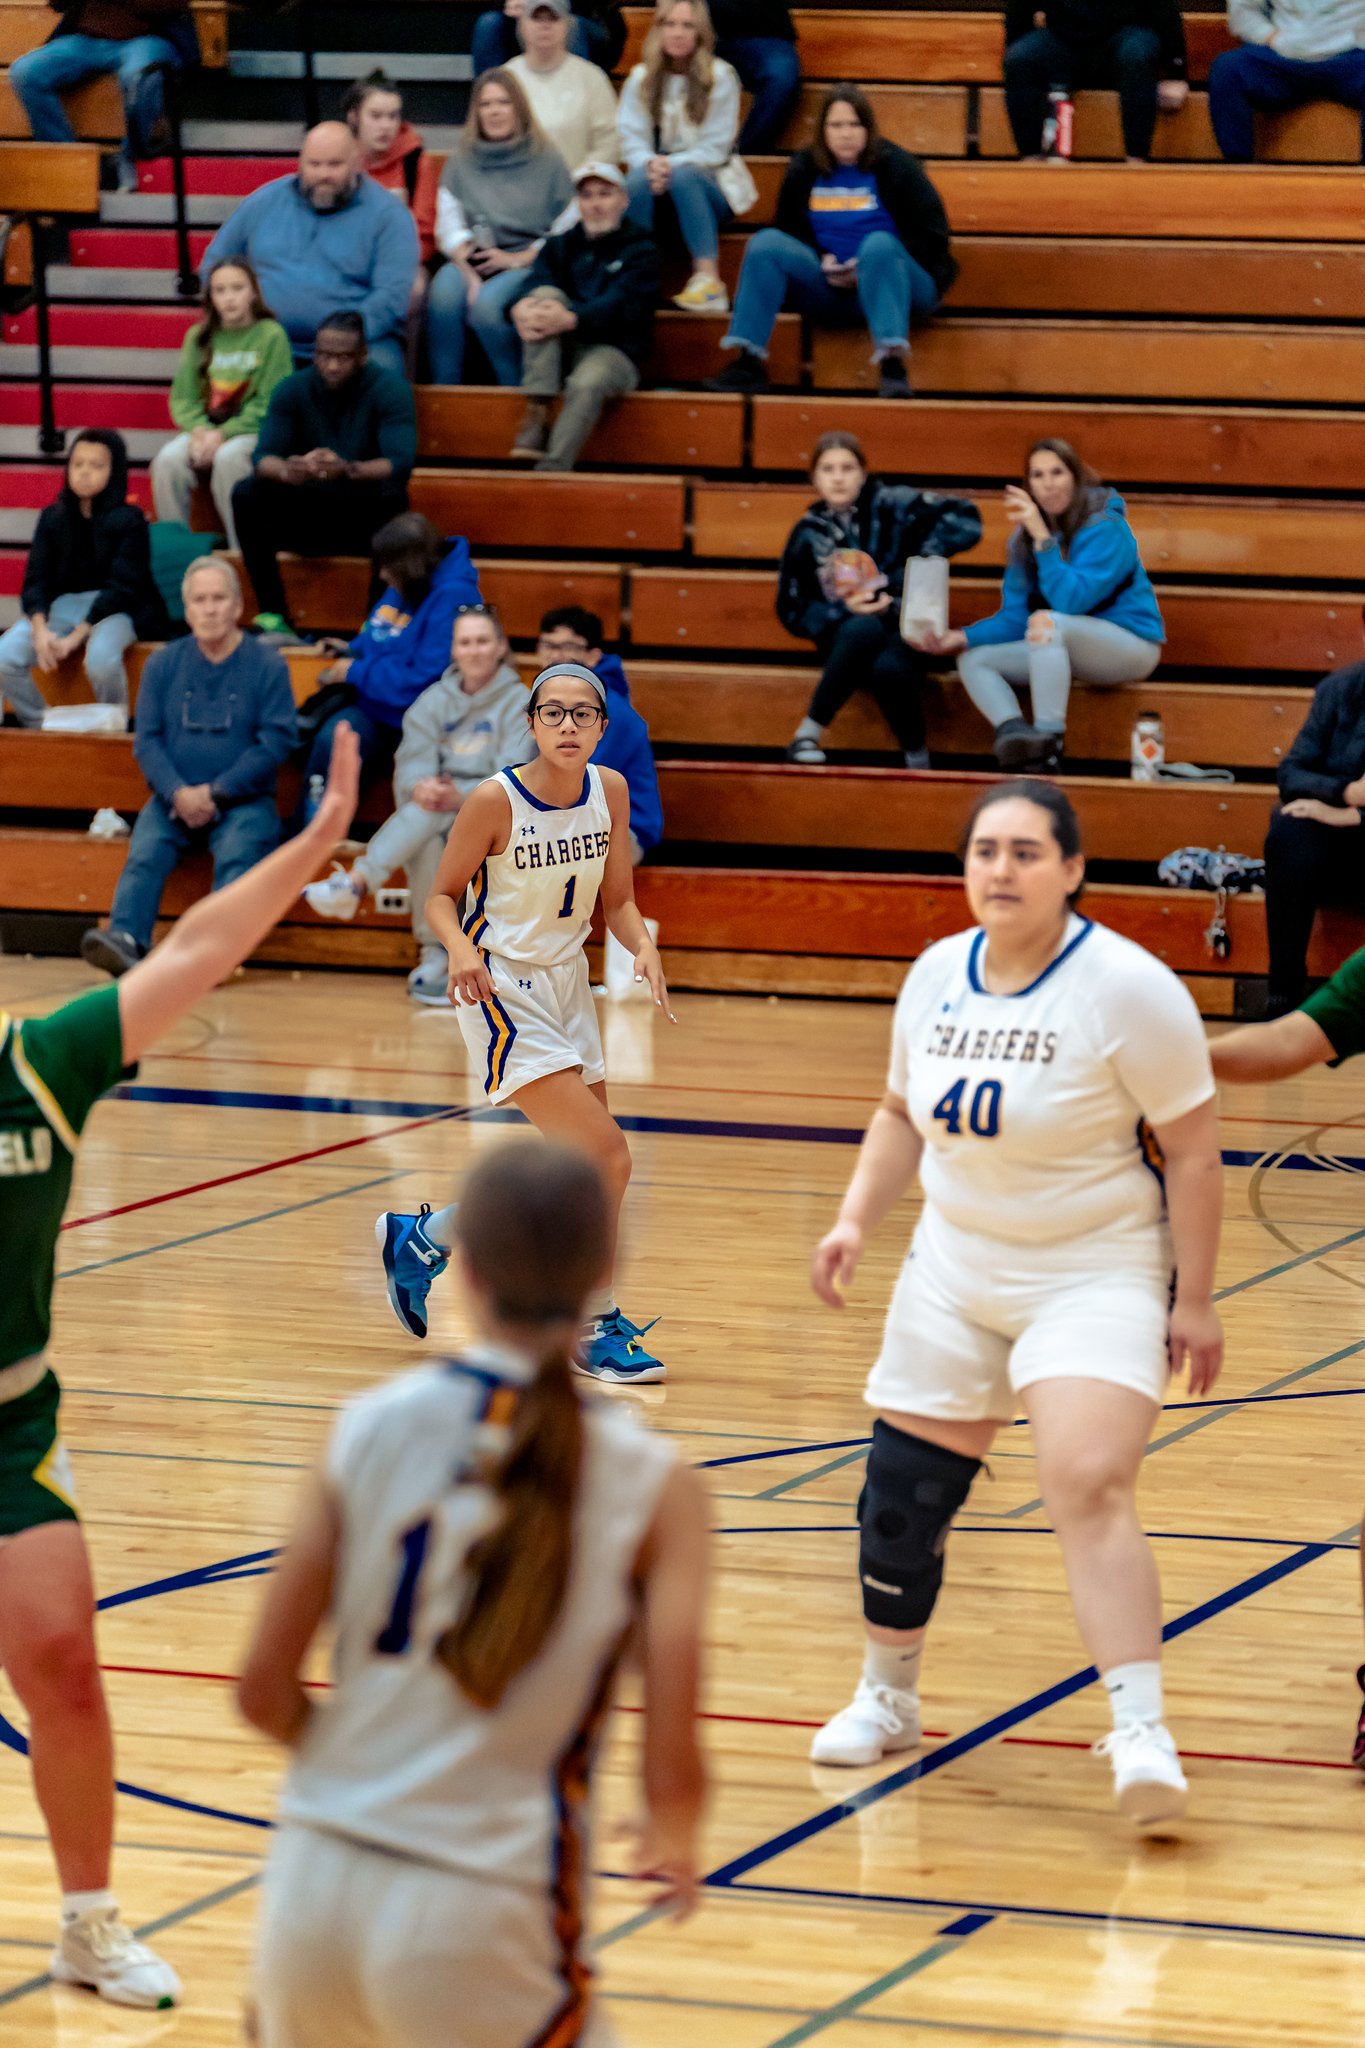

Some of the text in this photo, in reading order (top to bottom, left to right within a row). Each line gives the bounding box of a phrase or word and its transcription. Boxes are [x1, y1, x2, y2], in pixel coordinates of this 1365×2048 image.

[557, 874, 577, 919] 1
[926, 1023, 1058, 1064] CHARGERS
[932, 1077, 1003, 1138] 40
[374, 1517, 432, 1655] 1
